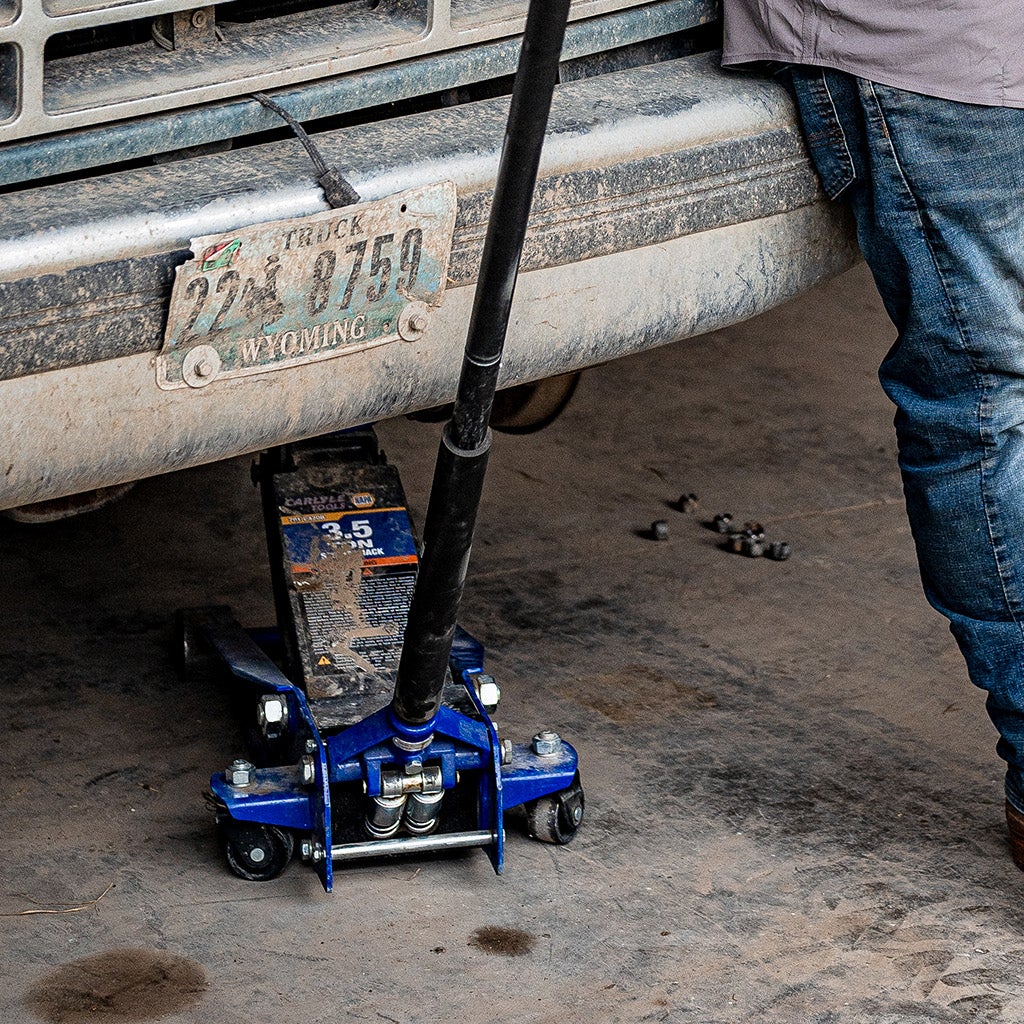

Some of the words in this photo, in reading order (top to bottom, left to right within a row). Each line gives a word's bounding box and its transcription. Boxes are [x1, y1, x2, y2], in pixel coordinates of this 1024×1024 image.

[282, 215, 366, 251] TRUCK
[241, 315, 366, 363] WYOMING
[284, 494, 346, 507] CARLYLE
[310, 502, 346, 512] TOOLS
[321, 520, 373, 541] 3.5
